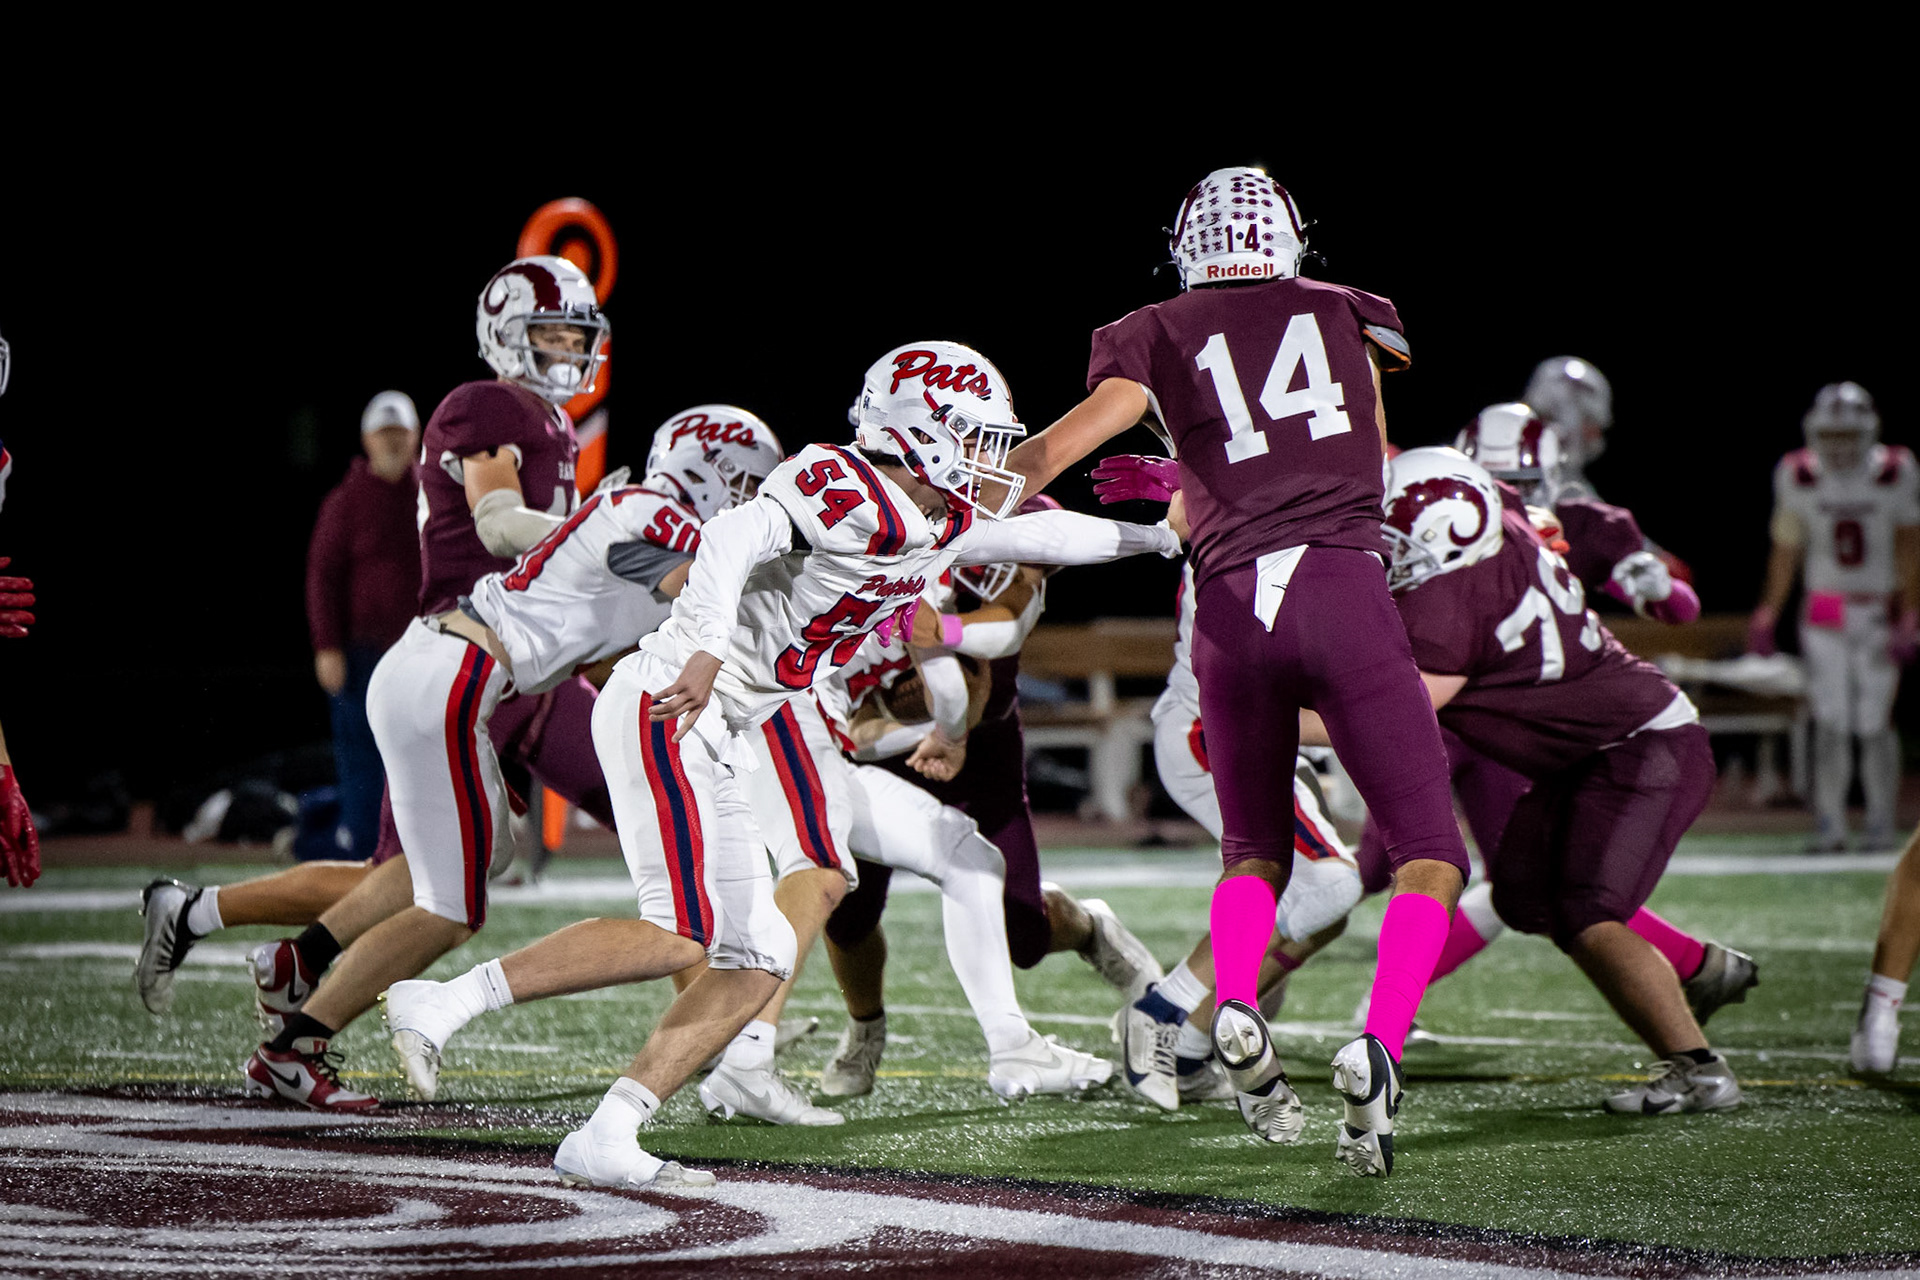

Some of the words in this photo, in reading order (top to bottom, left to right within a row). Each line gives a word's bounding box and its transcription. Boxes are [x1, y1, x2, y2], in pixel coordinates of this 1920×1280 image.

[1225, 223, 1260, 253] 14
[1206, 263, 1274, 279] Riddell
[889, 349, 992, 401] Pats
[1194, 312, 1352, 465] 14
[668, 412, 759, 451] Pats
[795, 457, 866, 530] 54
